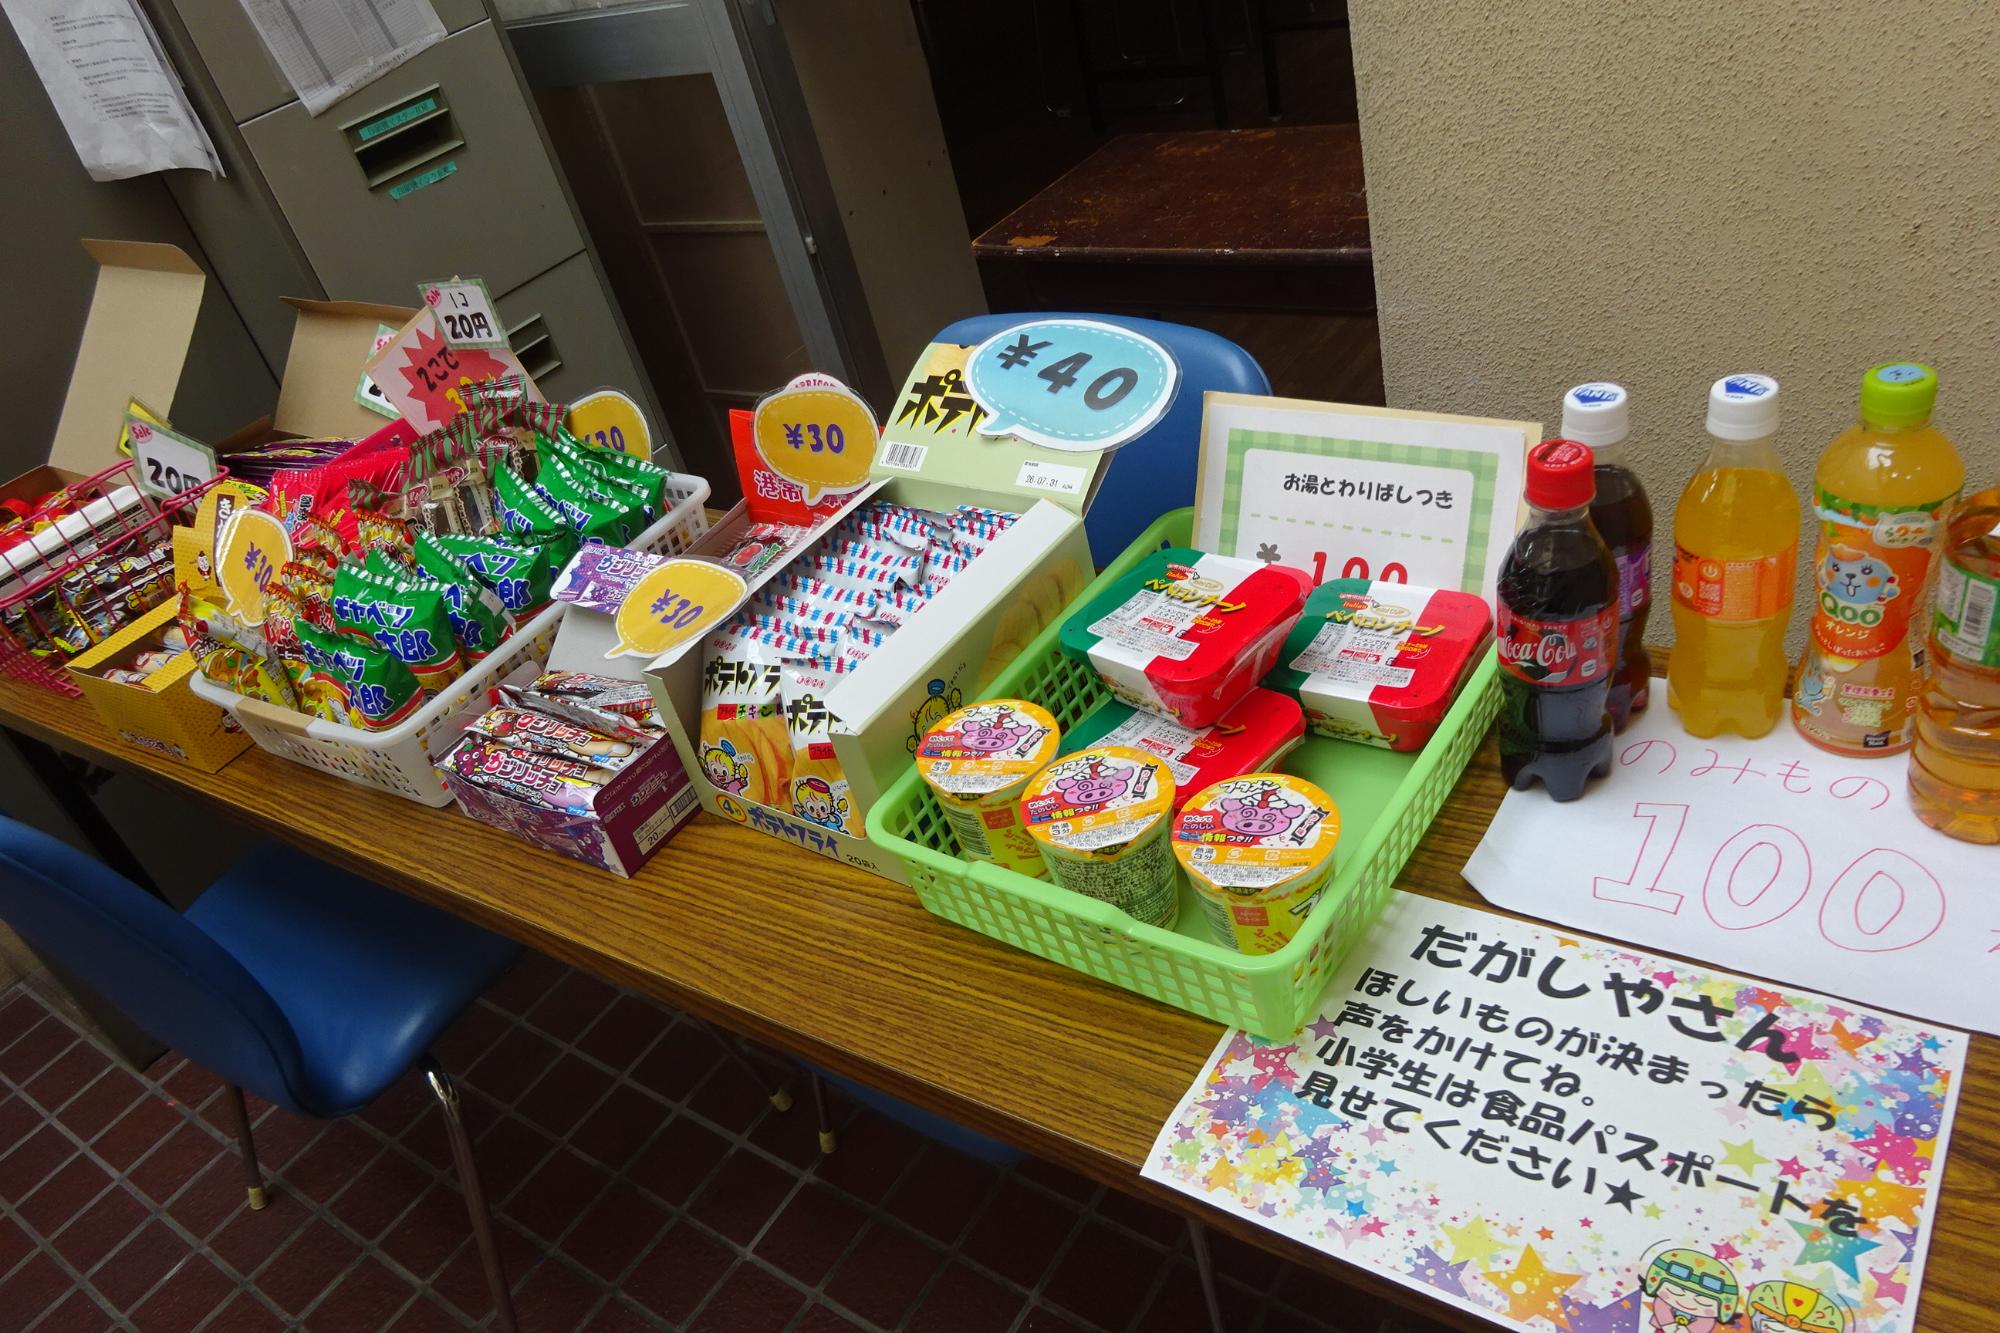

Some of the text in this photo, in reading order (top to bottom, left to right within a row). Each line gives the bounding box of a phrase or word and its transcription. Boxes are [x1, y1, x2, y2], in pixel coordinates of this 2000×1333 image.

[444, 311, 493, 339] 20円
[996, 333, 1139, 411] ¥40
[1573, 388, 1618, 403] FANTA
[782, 423, 845, 454] ¥30
[1026, 474, 1059, 488] 26.07.31
[1283, 472, 1454, 510] お湯とわりばしつき
[334, 594, 416, 629] キャベツ
[650, 588, 705, 630] ¥30
[1144, 578, 1248, 614] ペペロンチーノ
[1325, 610, 1446, 637] ペペロンチーノ
[1826, 621, 1871, 640] オレンジ
[1497, 633, 1578, 667] Coca-Cola
[1619, 738, 1892, 811] のみもの
[746, 805, 841, 859] ポテトフライ
[1592, 801, 1947, 953] 100
[1408, 922, 1802, 1067] だがしやさん
[1332, 997, 1596, 1109] 声をかけてね。
[1354, 965, 1838, 1133] ほしいものが決まったら
[1315, 1036, 1868, 1240] 小学生は食品パスポートを
